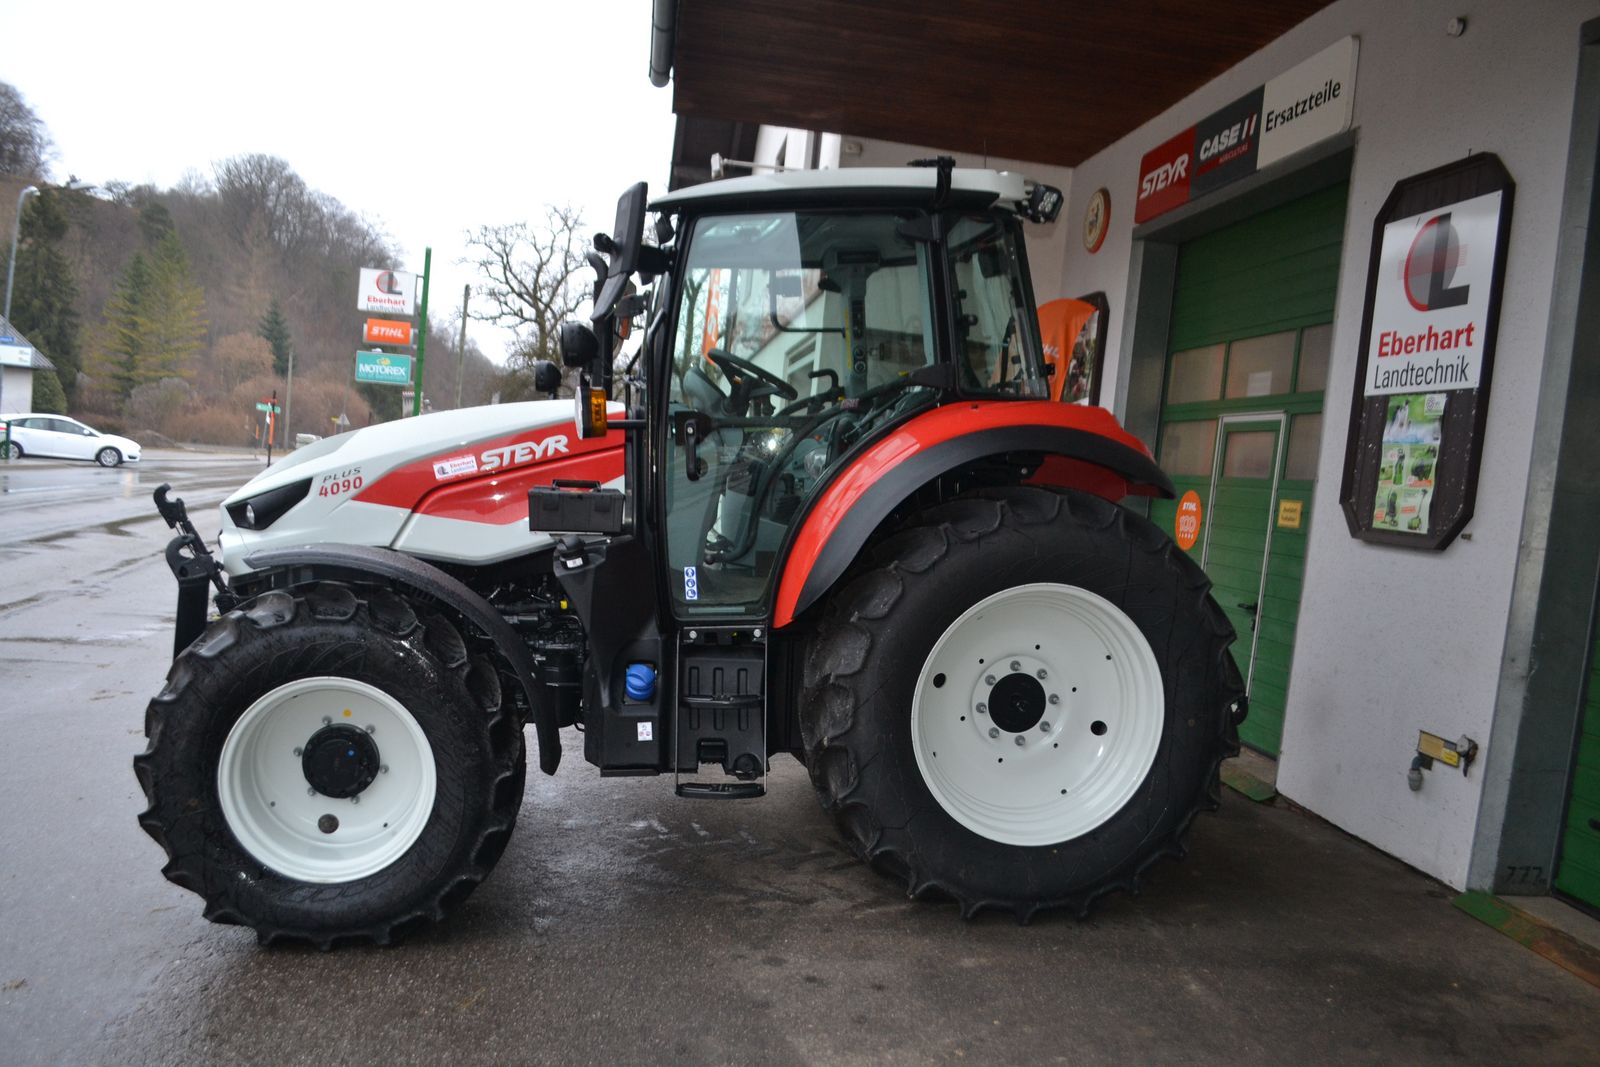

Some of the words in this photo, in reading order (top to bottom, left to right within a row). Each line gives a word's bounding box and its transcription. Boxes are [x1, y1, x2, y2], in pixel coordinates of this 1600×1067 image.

[1265, 80, 1341, 132] Ersatzteile
[1200, 122, 1242, 160] CASE
[1139, 154, 1189, 200] STEYR
[367, 295, 407, 306] Eberhart
[370, 326, 404, 338] STIHL
[1377, 322, 1476, 358] Eberhart
[359, 363, 406, 376] MOTOREX
[1373, 355, 1469, 390] Landtechnik
[479, 434, 570, 471] STEYR
[319, 476, 363, 497] 4090
[323, 466, 361, 483] PLUS
